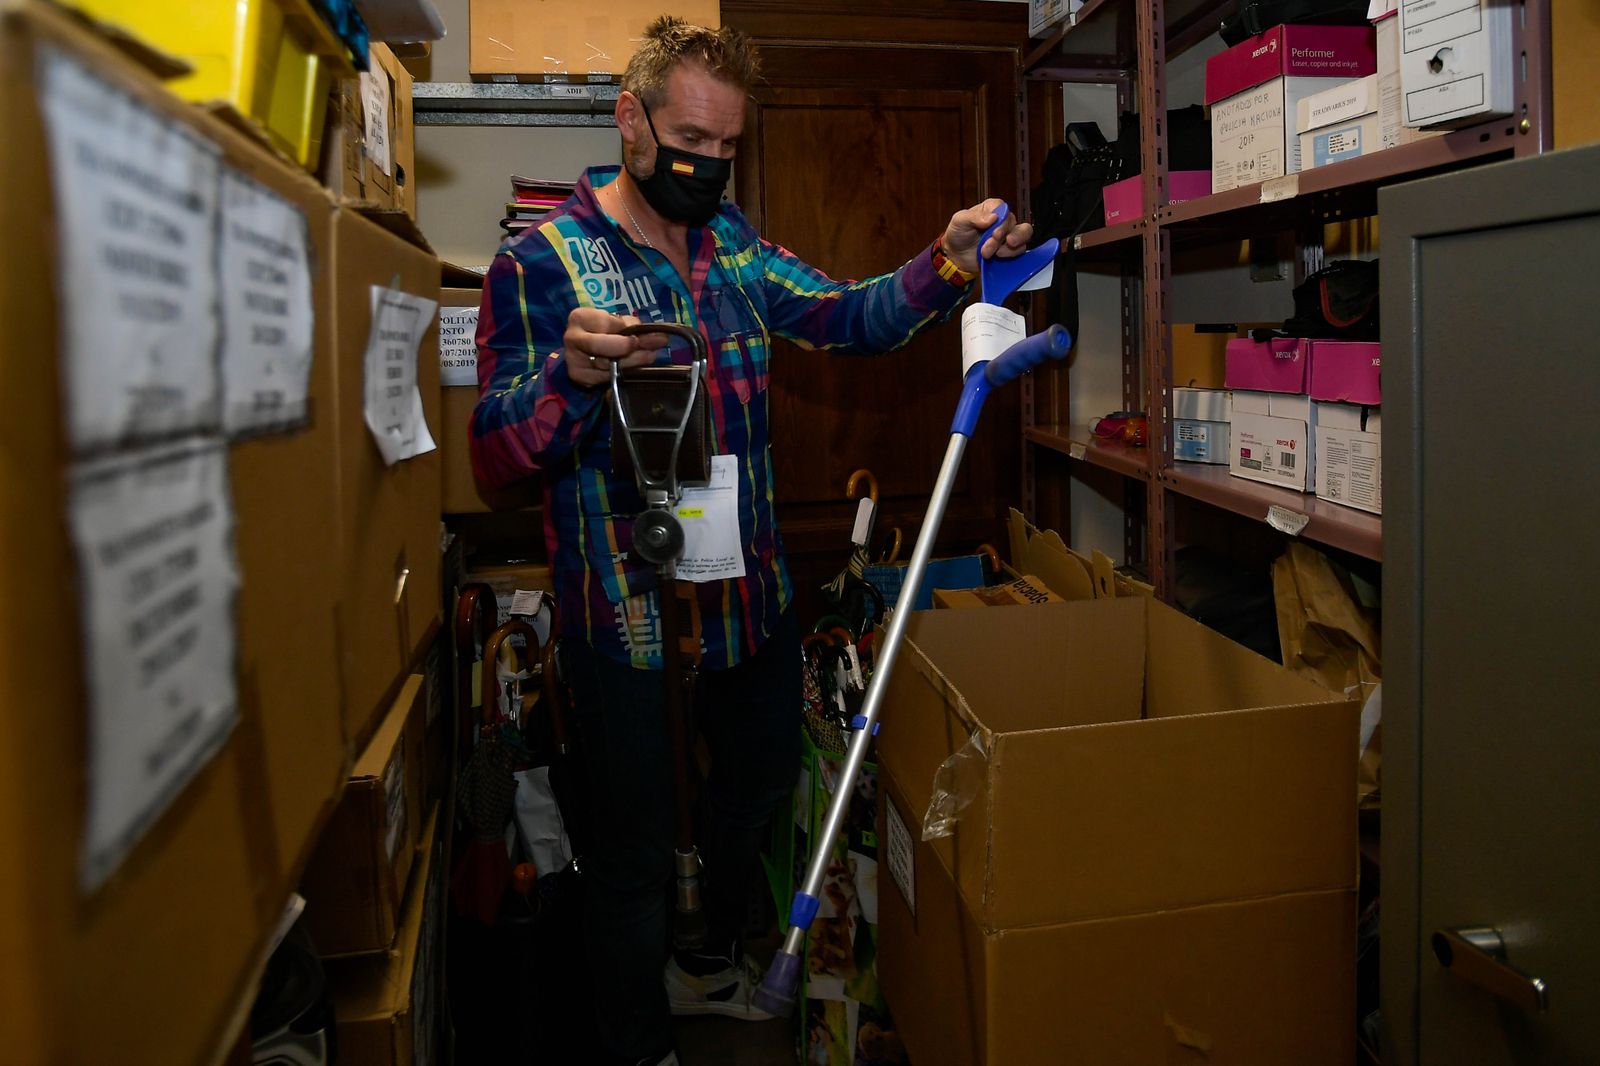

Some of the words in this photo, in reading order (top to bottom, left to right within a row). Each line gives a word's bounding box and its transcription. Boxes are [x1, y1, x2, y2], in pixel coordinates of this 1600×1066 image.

[1252, 45, 1269, 58] xerox
[1291, 47, 1335, 58] Performer
[1254, 93, 1269, 105] POR
[1312, 100, 1346, 117] STRADIVARIUS
[1238, 134, 1254, 150] 2017
[442, 338, 471, 346] 360780
[1275, 351, 1291, 359] xerox
[1276, 439, 1289, 447] xerox
